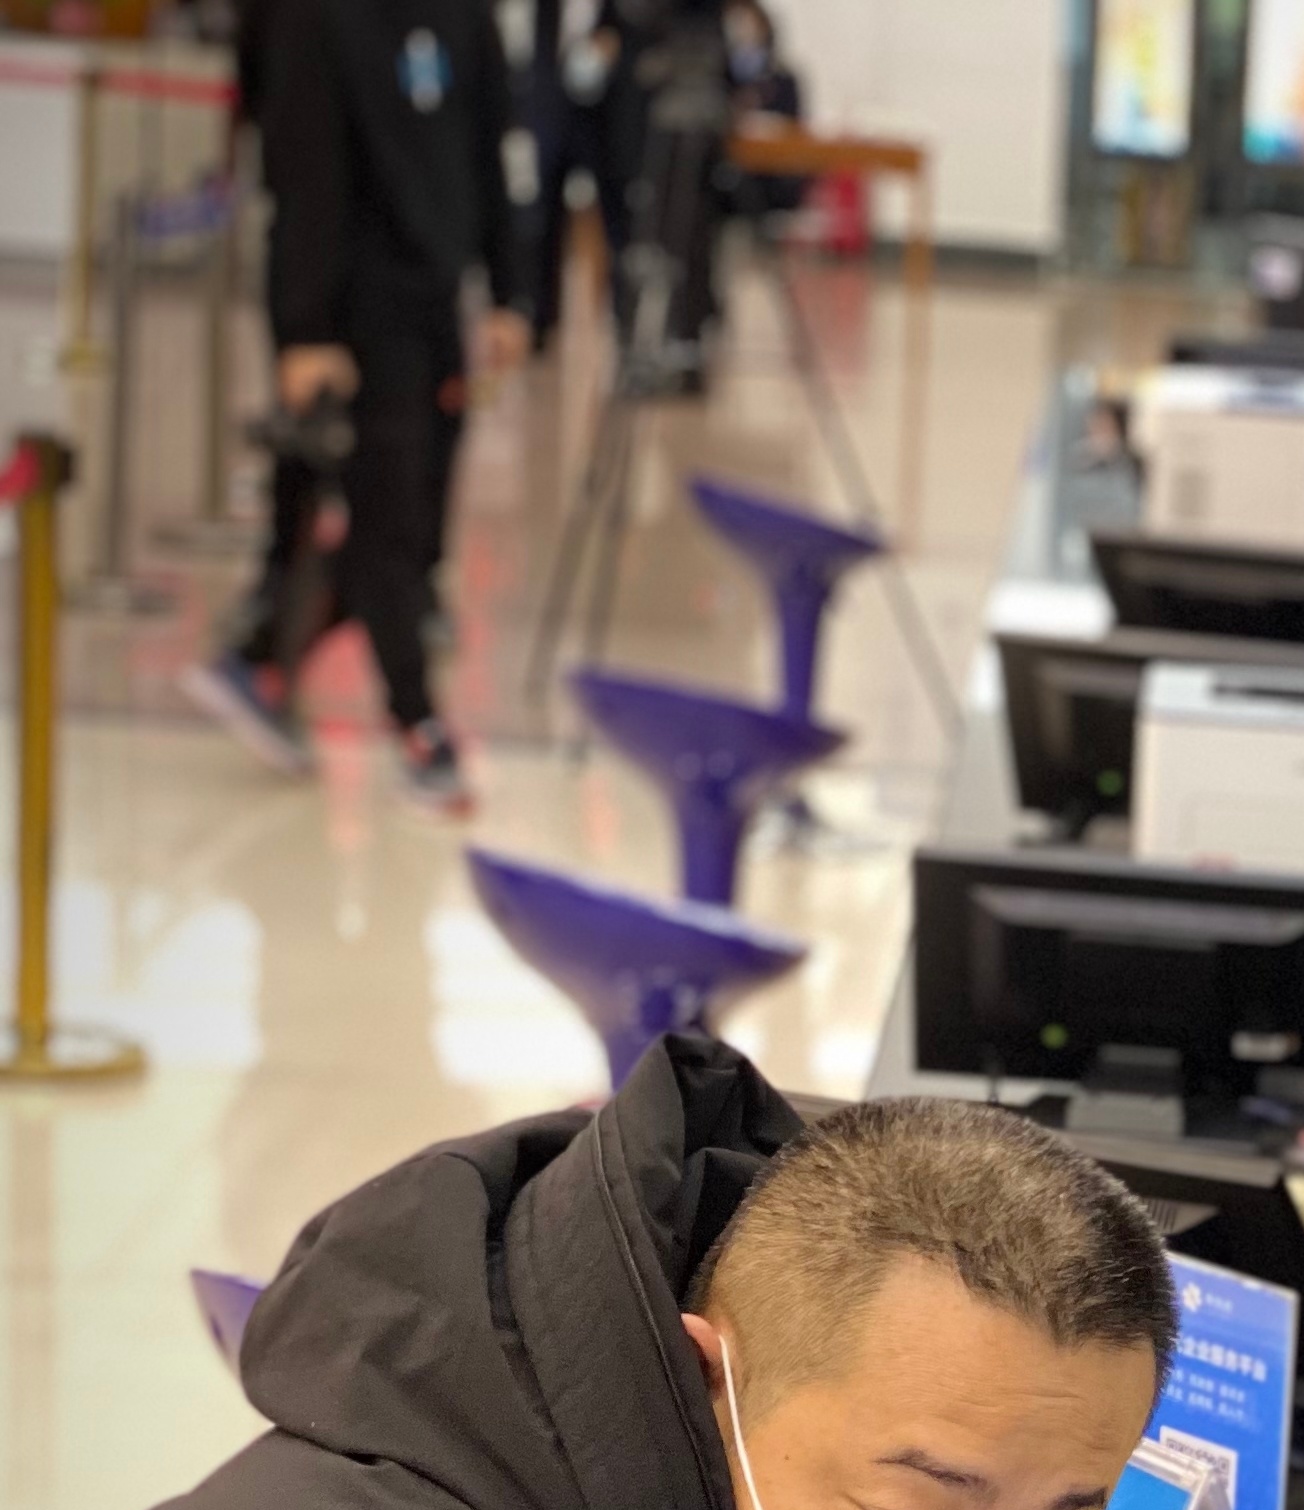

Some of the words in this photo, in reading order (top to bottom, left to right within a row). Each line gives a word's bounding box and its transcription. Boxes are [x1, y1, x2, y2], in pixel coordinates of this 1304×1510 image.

[1177, 1335, 1268, 1384] 企业服务平台
